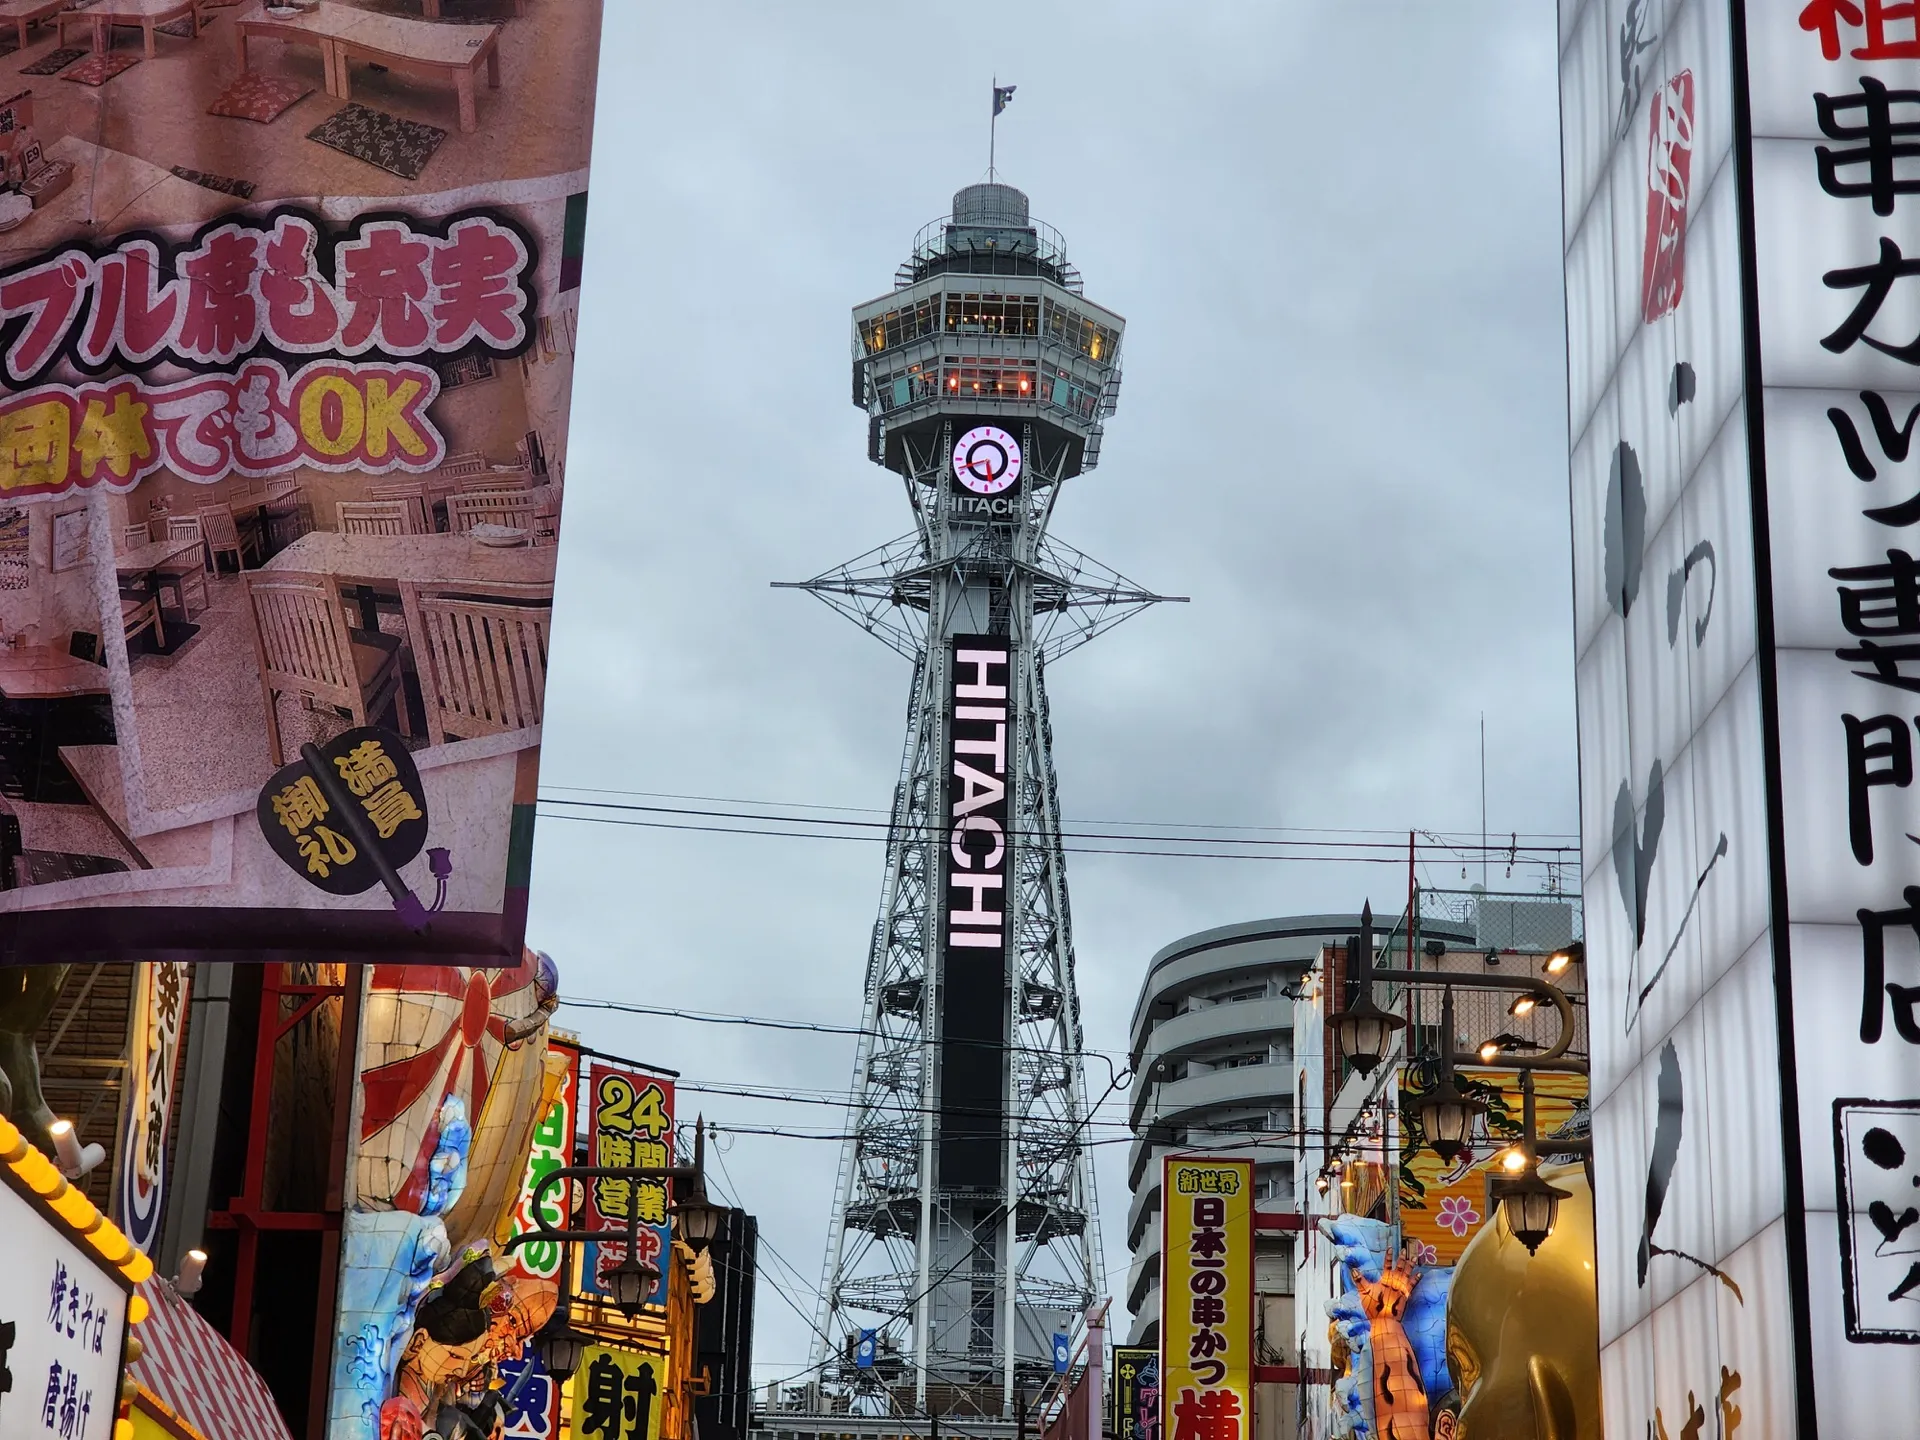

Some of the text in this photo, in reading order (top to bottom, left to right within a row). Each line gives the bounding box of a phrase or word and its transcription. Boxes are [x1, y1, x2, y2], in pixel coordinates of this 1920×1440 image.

[0, 372, 432, 492] 団体でもOK
[941, 497, 1030, 514] HITACHI
[271, 776, 356, 878] 御礼
[334, 741, 422, 838] 満員
[951, 650, 1007, 947] HITACHI
[599, 1078, 670, 1138] 24
[598, 1134, 667, 1181] 時間
[598, 1178, 666, 1223] 営業
[1178, 1169, 1239, 1194] 新世界
[47, 1258, 108, 1356] 焼きそば
[1190, 1198, 1226, 1385] 日本一の串かつ
[41, 1359, 92, 1440] 唐揚げ
[581, 1353, 658, 1440] 射
